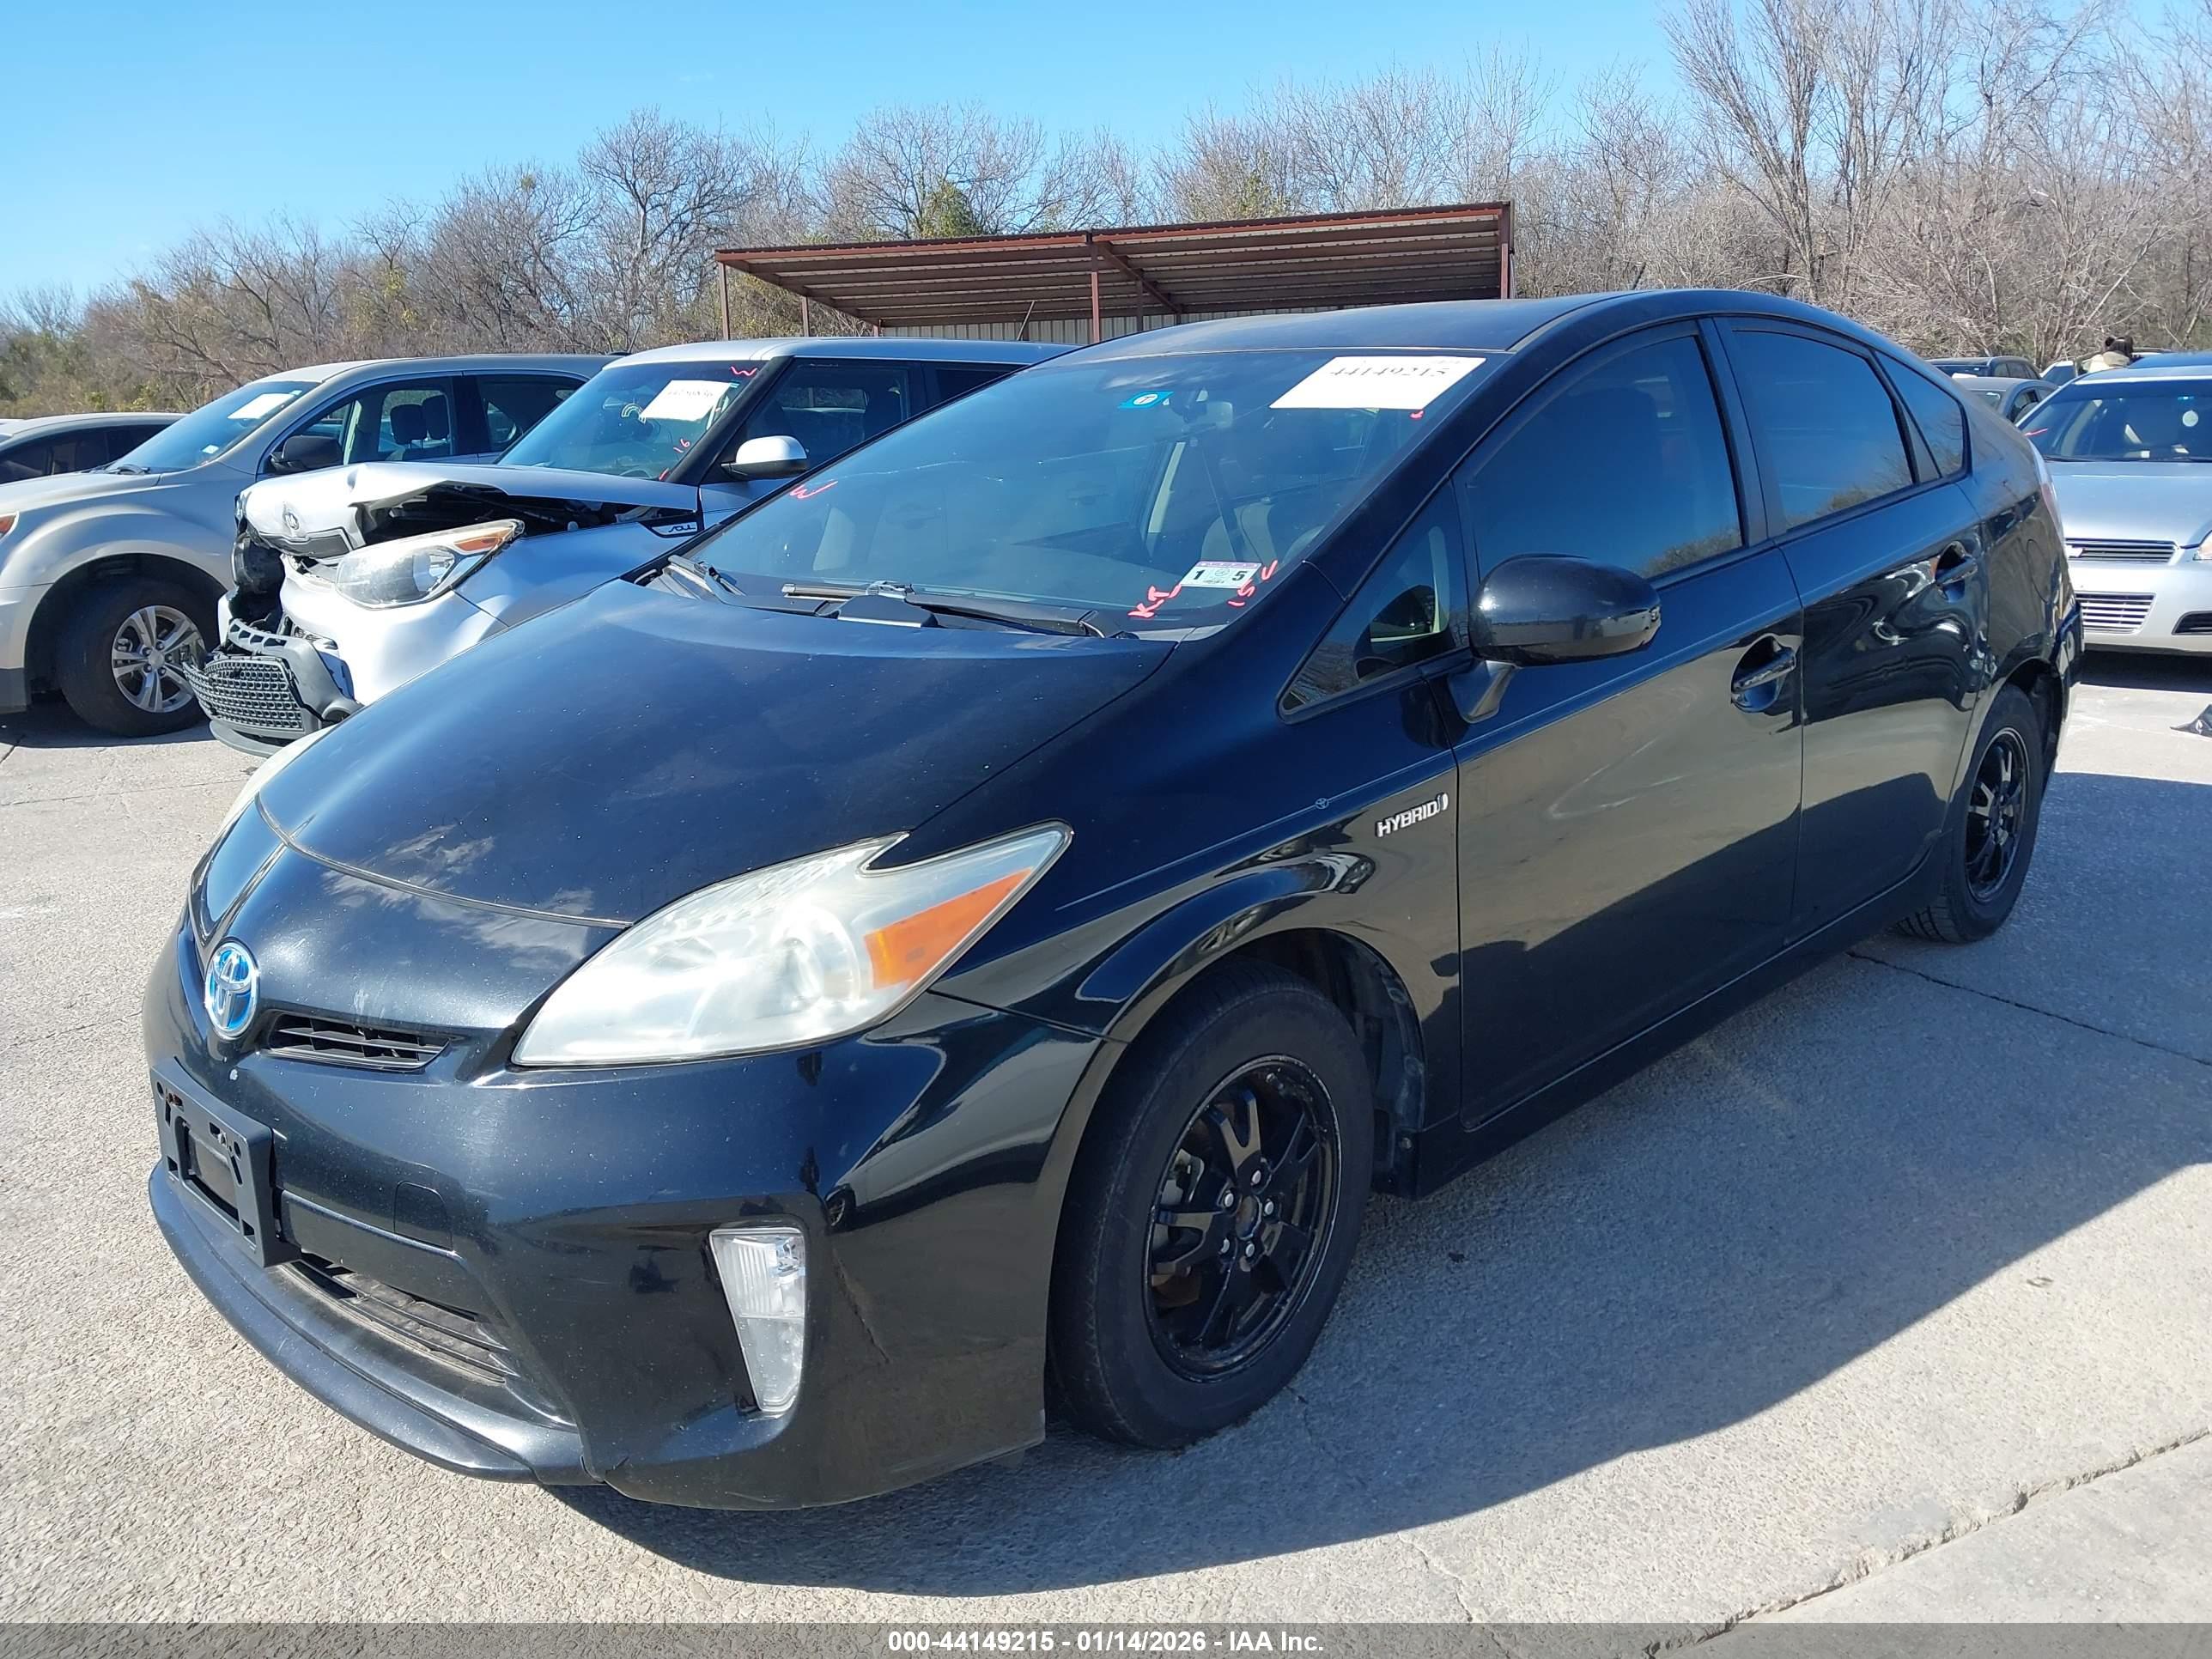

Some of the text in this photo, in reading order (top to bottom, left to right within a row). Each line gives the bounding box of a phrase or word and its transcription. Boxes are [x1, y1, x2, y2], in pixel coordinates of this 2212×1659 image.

[1194, 569, 1249, 581] 1 5
[1376, 799, 1438, 837] HYBRID
